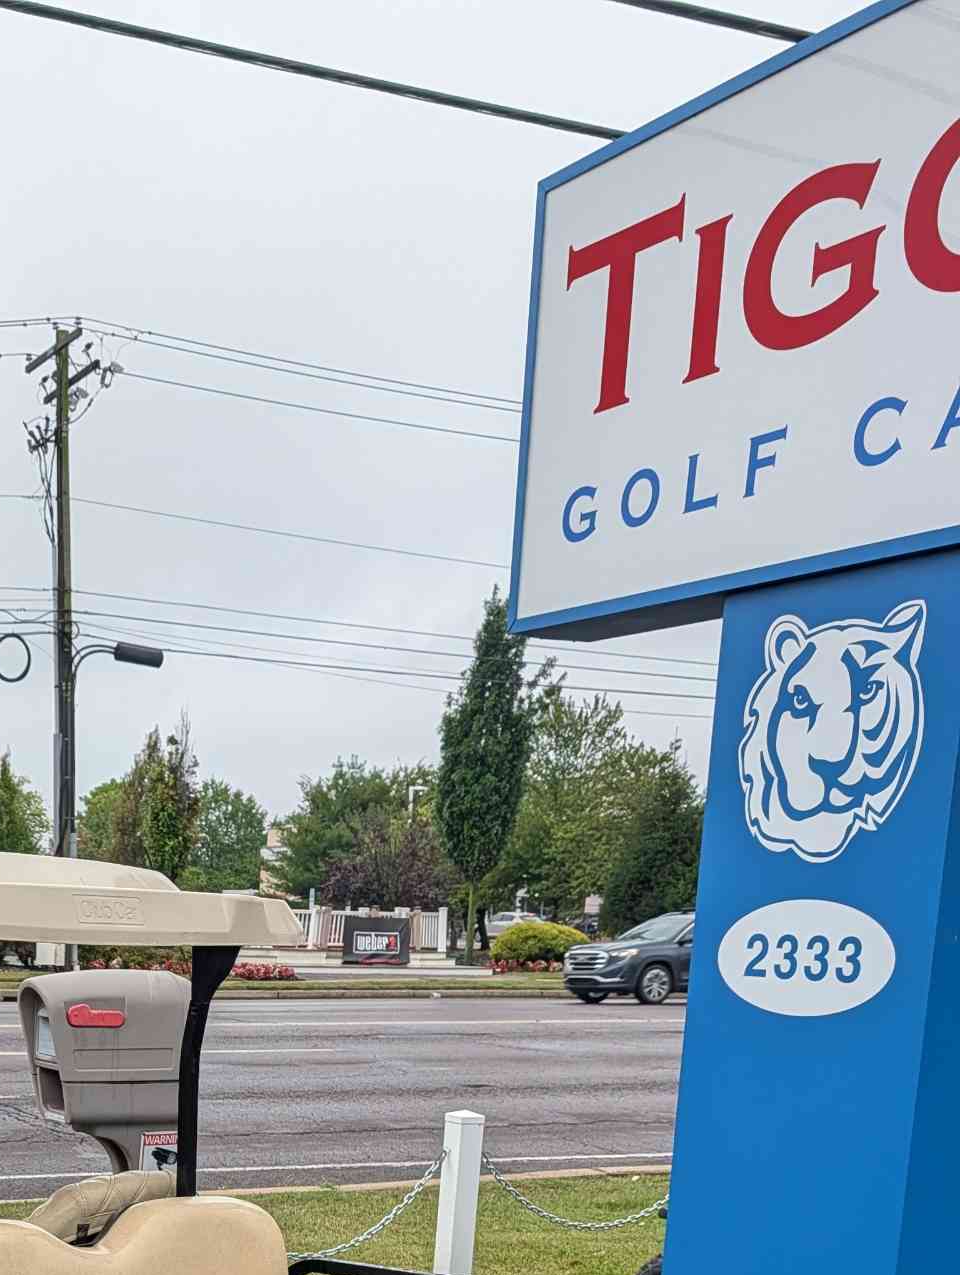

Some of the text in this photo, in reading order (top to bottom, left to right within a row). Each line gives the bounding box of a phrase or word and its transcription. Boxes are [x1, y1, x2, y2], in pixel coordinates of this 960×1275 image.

[561, 425, 789, 543] GOLF
[356, 932, 389, 951] weber
[743, 933, 863, 984] 2333
[144, 1134, 177, 1145] WARNI
